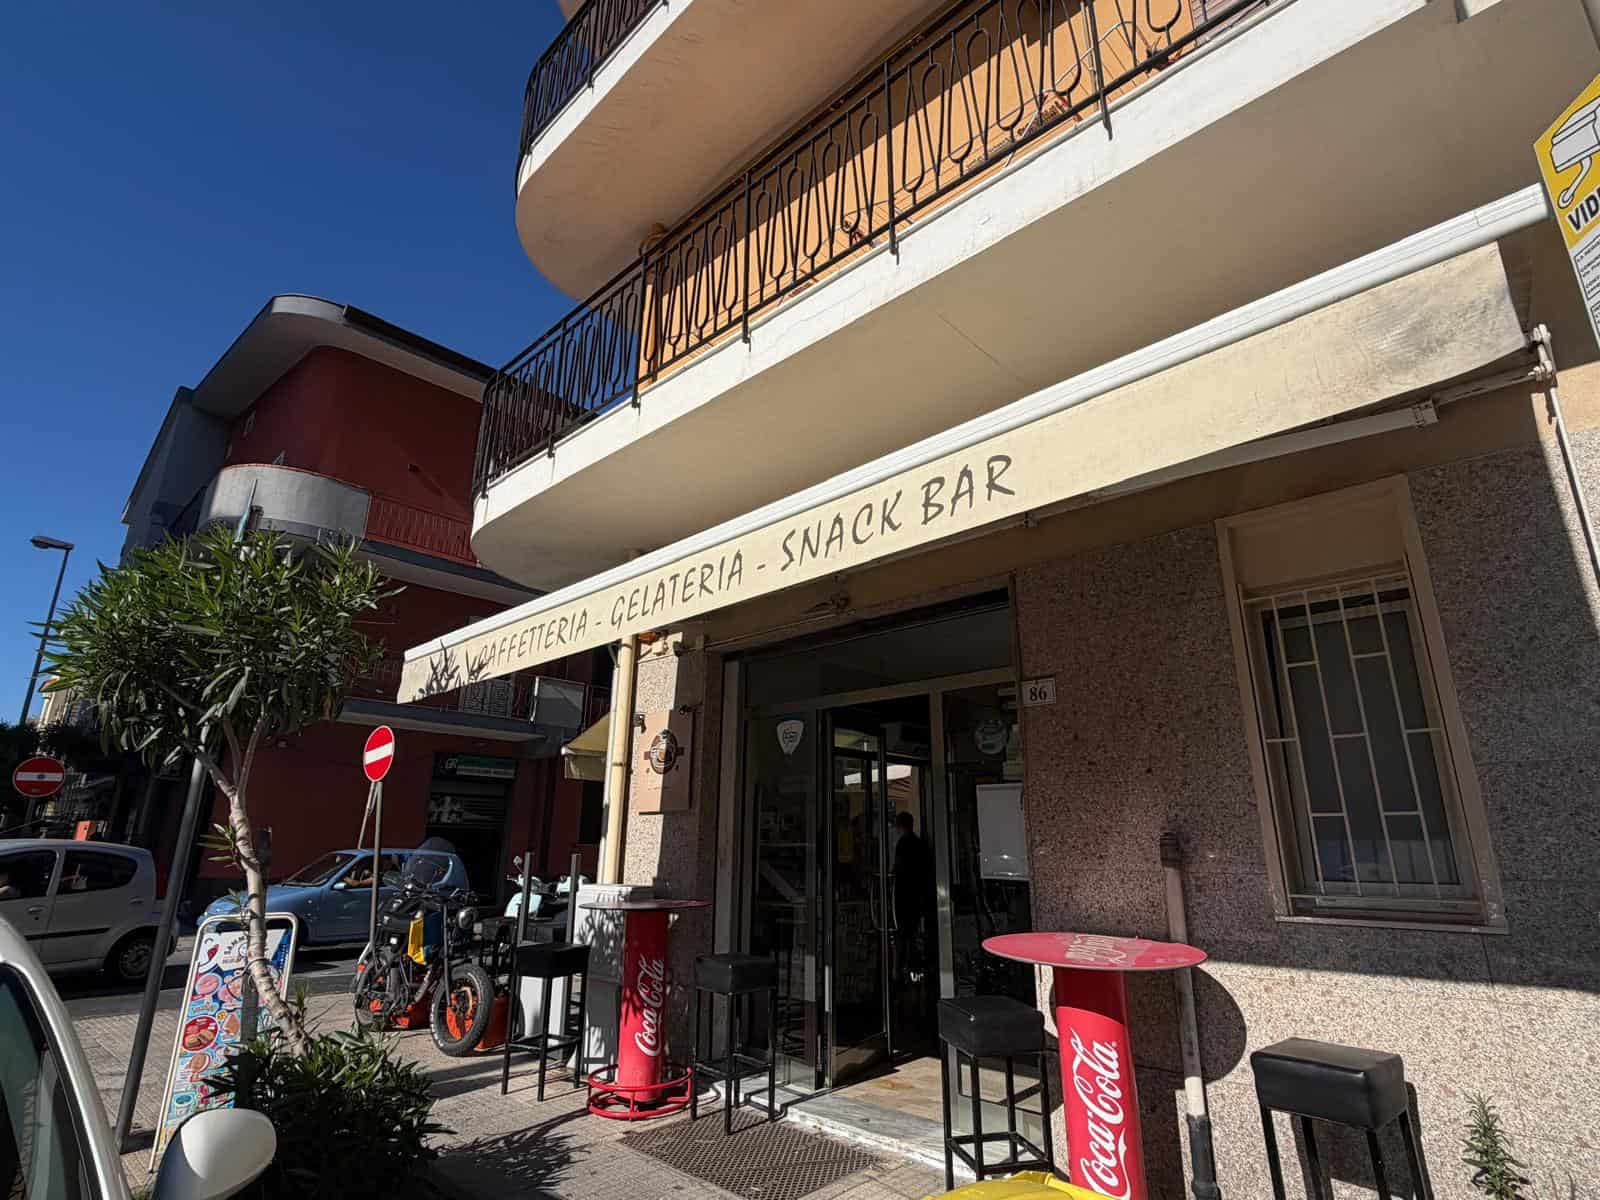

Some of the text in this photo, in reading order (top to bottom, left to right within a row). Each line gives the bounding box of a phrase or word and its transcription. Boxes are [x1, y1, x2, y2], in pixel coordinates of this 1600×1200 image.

[479, 608, 587, 668] CAFFETTERIA
[611, 549, 743, 630] GELATERIA
[781, 490, 903, 571] SNACK
[921, 454, 1015, 525] BAR
[1030, 686, 1047, 702] 86
